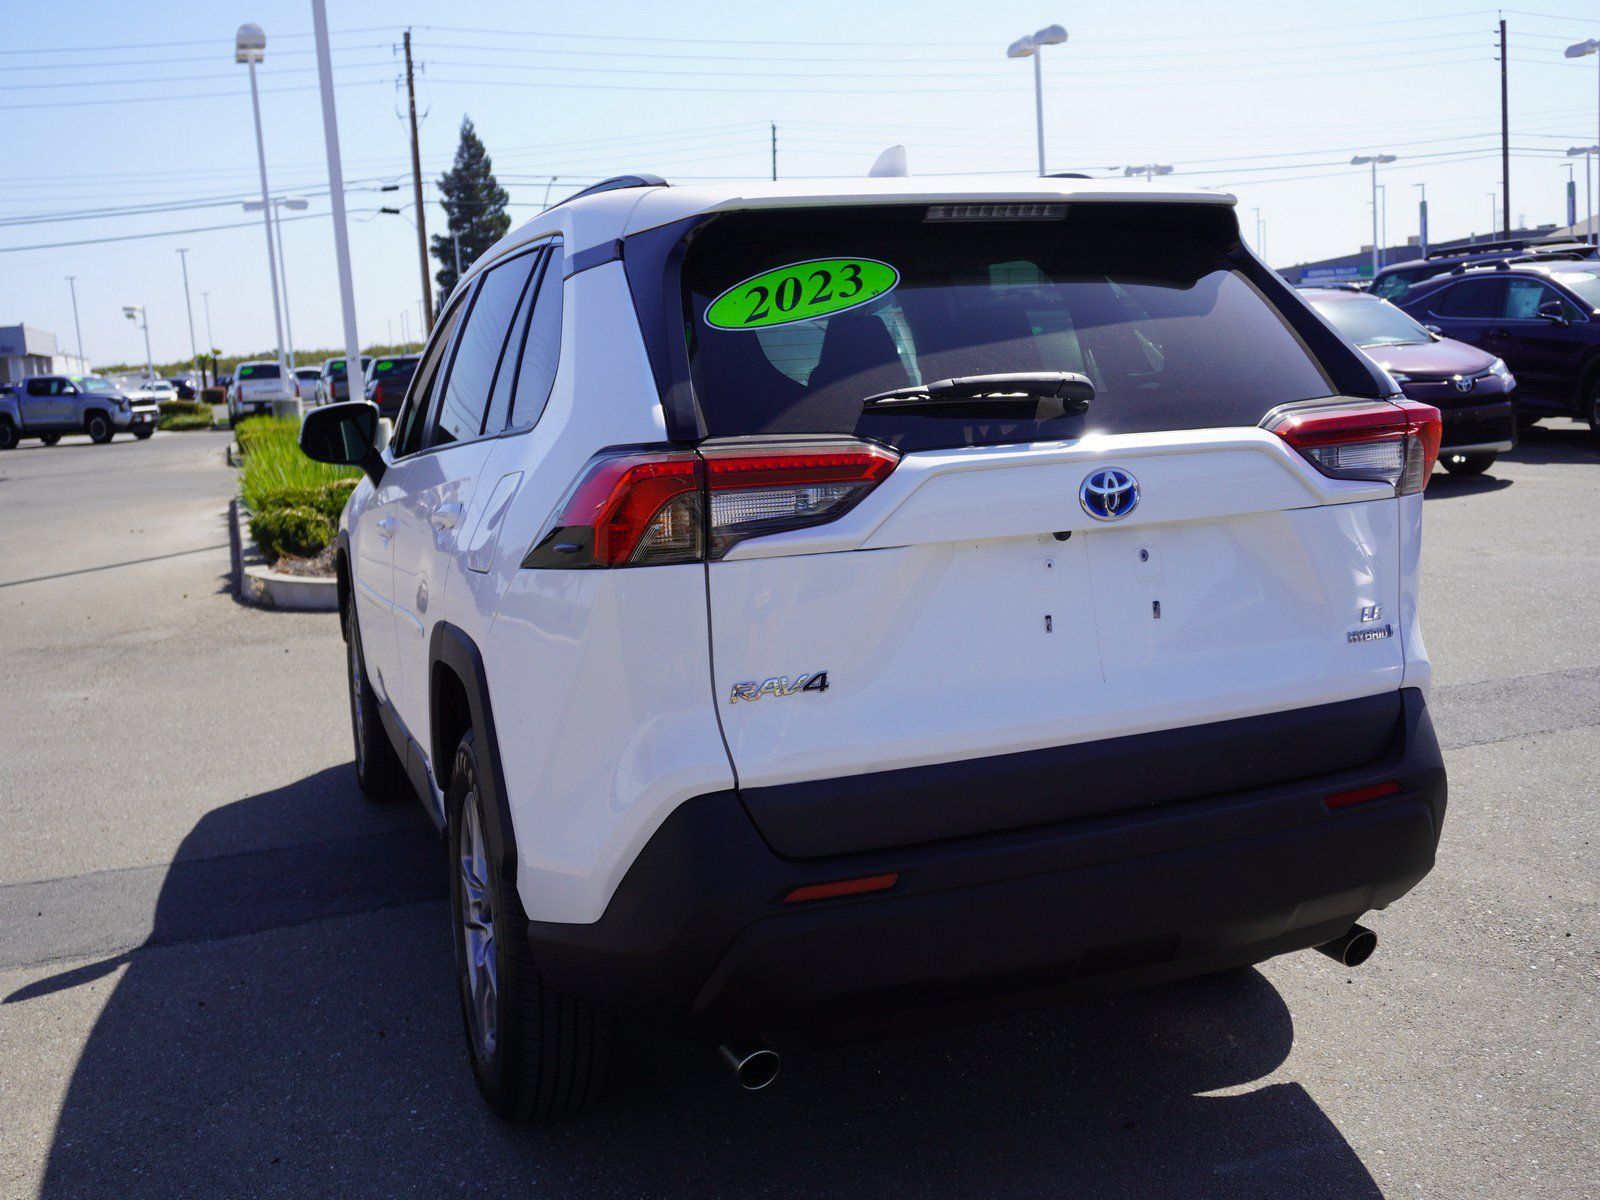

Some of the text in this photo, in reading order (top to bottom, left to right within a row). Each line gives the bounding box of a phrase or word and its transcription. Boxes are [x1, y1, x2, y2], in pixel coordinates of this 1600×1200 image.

[1336, 267, 1358, 275] VALLEY
[743, 263, 864, 324] 2023
[1361, 605, 1383, 622] LE
[1347, 626, 1390, 643] HYBRID
[729, 669, 830, 704] RAV4
